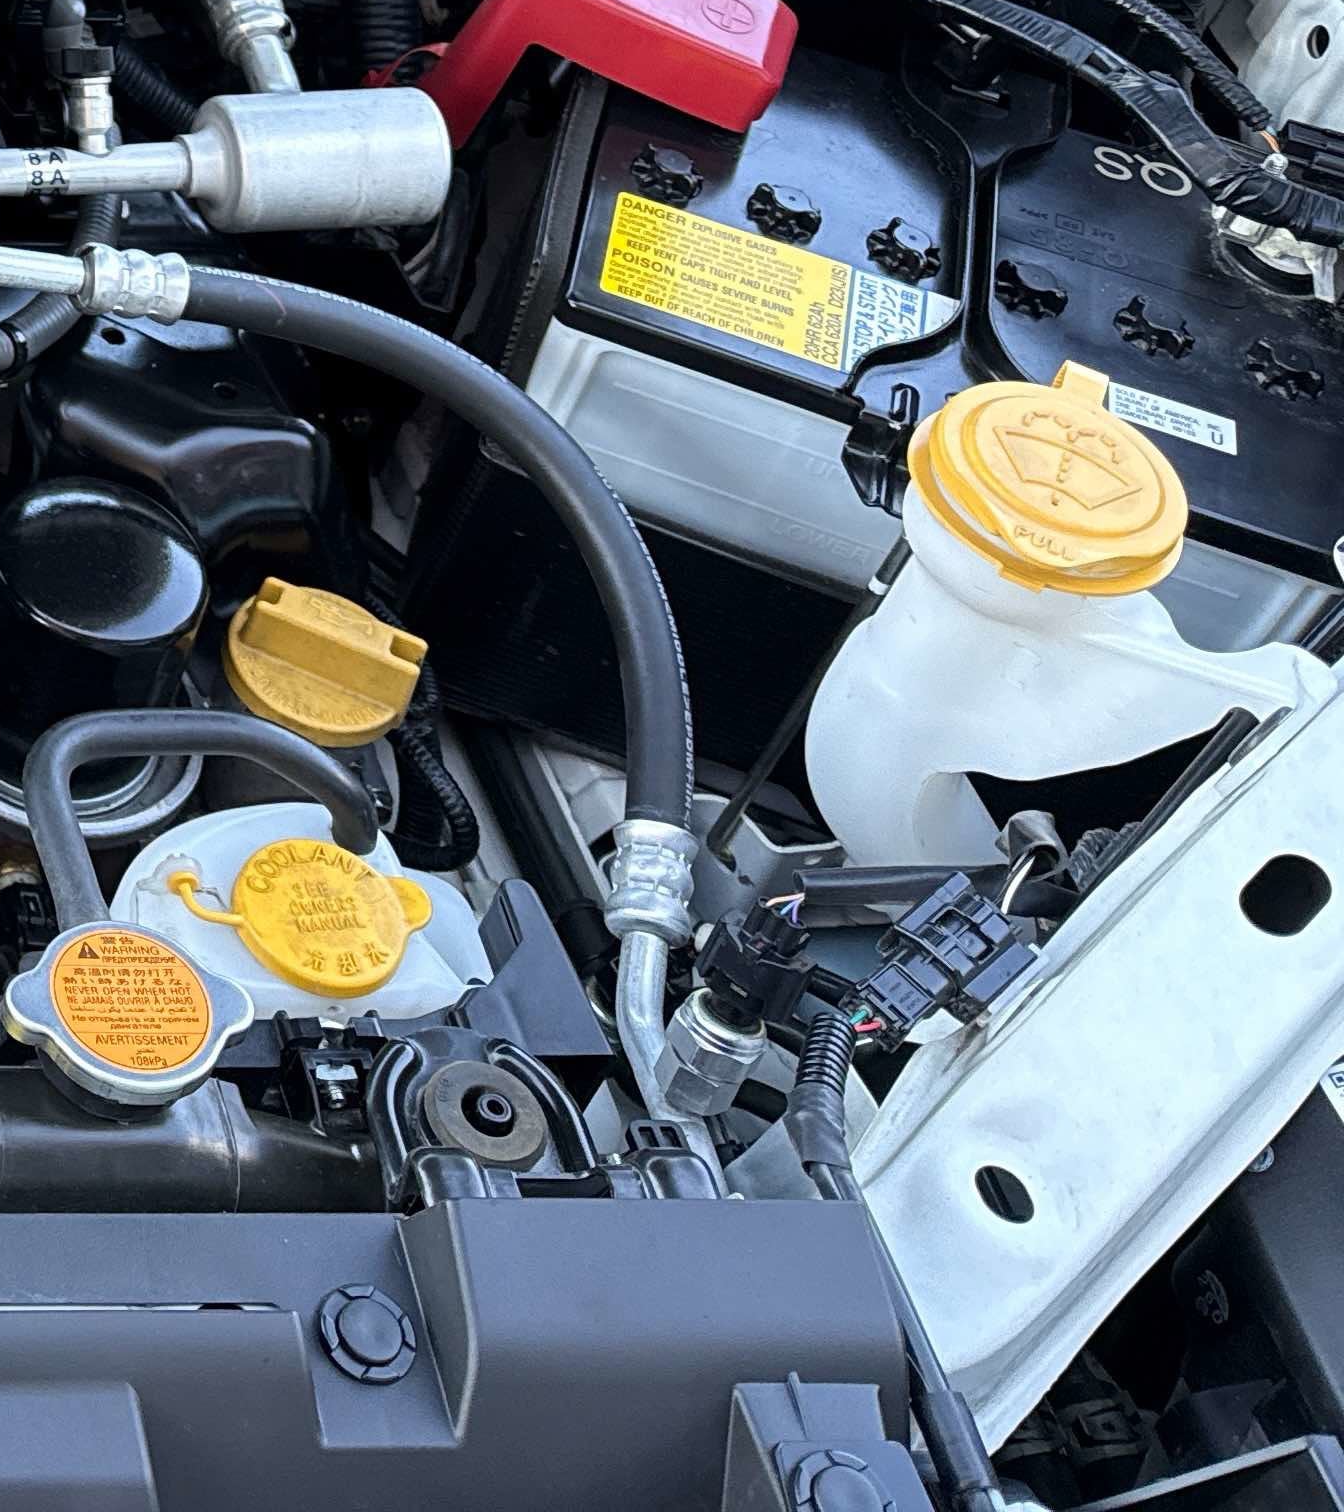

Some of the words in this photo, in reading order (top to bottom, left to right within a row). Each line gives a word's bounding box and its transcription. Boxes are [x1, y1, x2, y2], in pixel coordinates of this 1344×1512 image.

[620, 197, 687, 226] DANGER
[691, 221, 743, 244] EXPLOSIVE
[610, 247, 677, 277] POISON
[679, 271, 719, 291] CAUSES
[720, 285, 758, 304] SEVERE
[759, 298, 795, 316] BURNS
[625, 238, 651, 253] KEEP
[652, 247, 677, 262] VENT
[679, 256, 706, 272] CAPS
[739, 275, 761, 289] AND
[761, 283, 794, 301] LEVEL
[858, 275, 878, 310] START
[616, 284, 642, 299] KEEP
[643, 293, 664, 306] OUT
[665, 300, 680, 312] OF
[680, 305, 716, 324] REACH
[716, 318, 732, 329] OF
[732, 323, 785, 347] CHILDREN
[854, 318, 872, 348] STOP
[823, 339, 839, 364] CCA
[246, 844, 376, 893] COOLANT
[295, 913, 366, 933] MANUAL
[99, 945, 160, 955] WARNING
[64, 986, 98, 996] NEVER
[103, 986, 130, 996] OPEN
[134, 986, 166, 996] WHEN
[170, 986, 192, 996] HOT
[95, 1034, 189, 1046] AVERTISSEMENT
